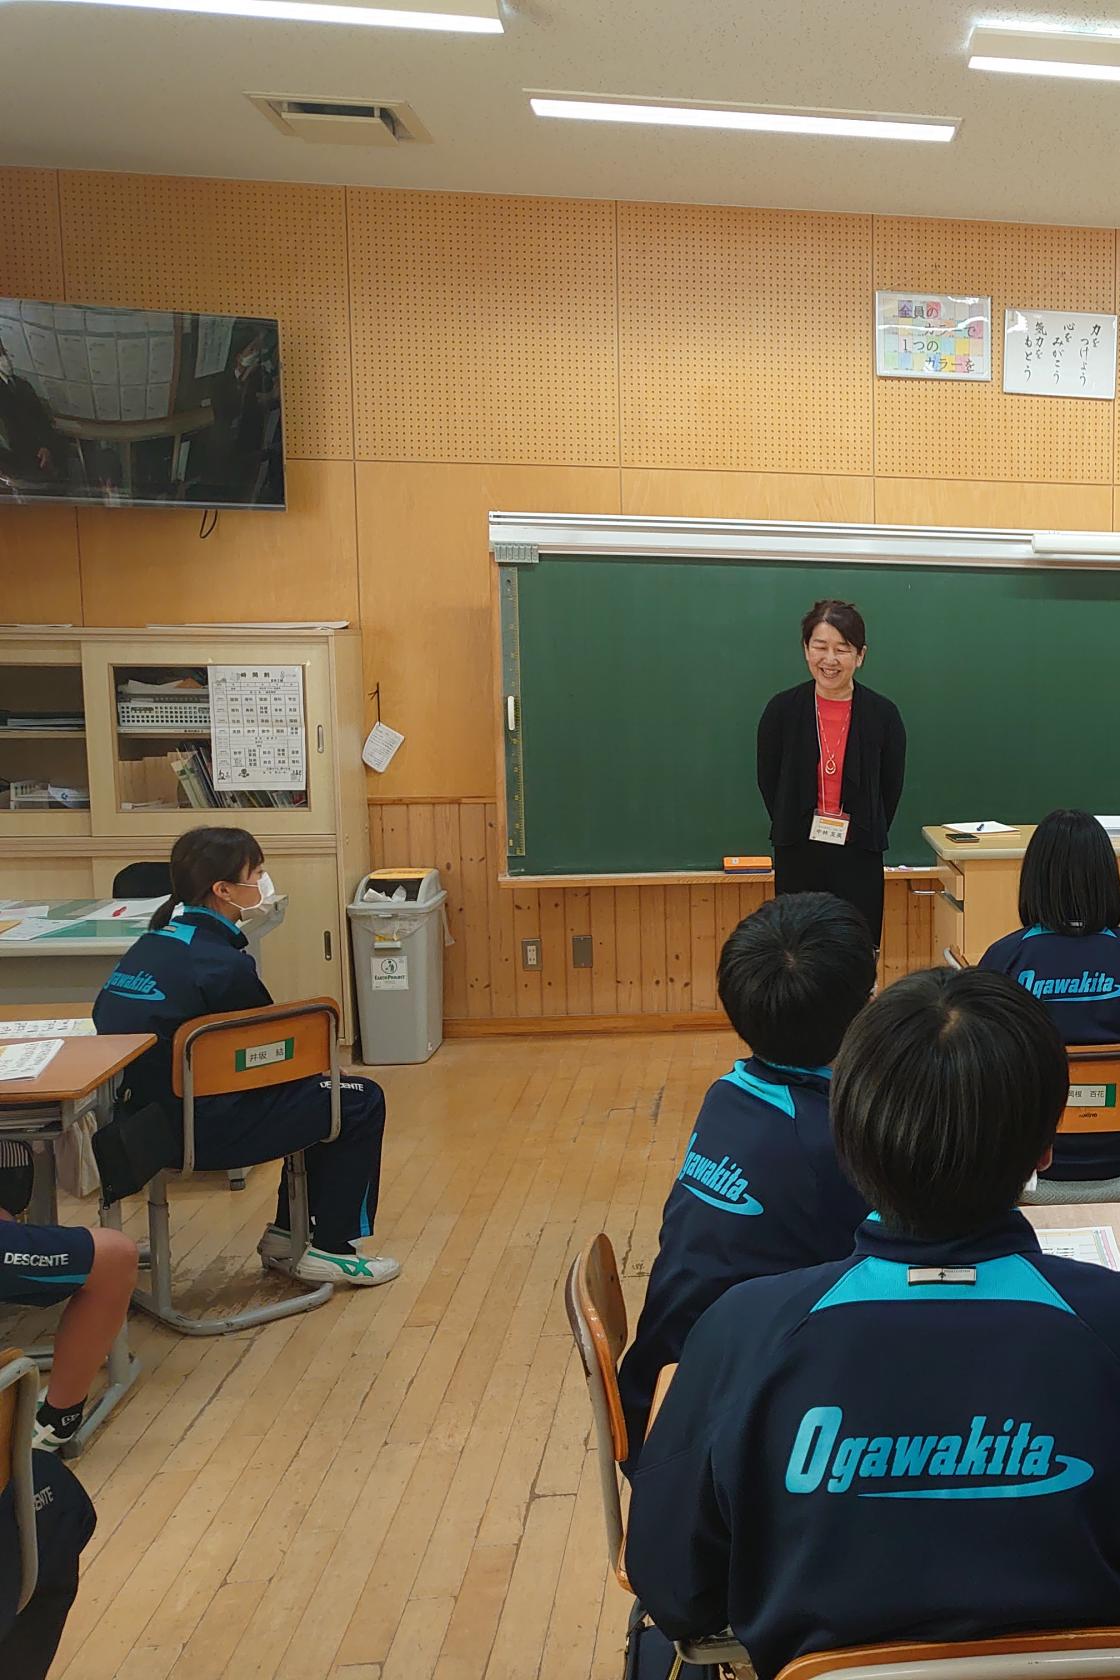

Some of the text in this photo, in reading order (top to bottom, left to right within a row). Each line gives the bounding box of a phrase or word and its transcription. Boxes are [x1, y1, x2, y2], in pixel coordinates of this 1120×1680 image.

[900, 304, 939, 319] 全員の
[903, 338, 939, 352] 1つの
[1035, 322, 1048, 360] 気力を
[1064, 322, 1075, 343] 心を
[1091, 323, 1102, 348] 力を
[925, 357, 975, 373] カラーを
[1024, 336, 1032, 383] もとう
[1053, 338, 1064, 385] みがこう
[1079, 338, 1089, 386] つけよう
[104, 963, 157, 993] awakita
[1018, 970, 1114, 999] Ogawakita
[320, 1081, 364, 1092] DEENTE
[679, 1132, 748, 1201] gawakita
[4, 1252, 69, 1267] DESCENTE
[784, 1406, 1057, 1494] Ogawakita
